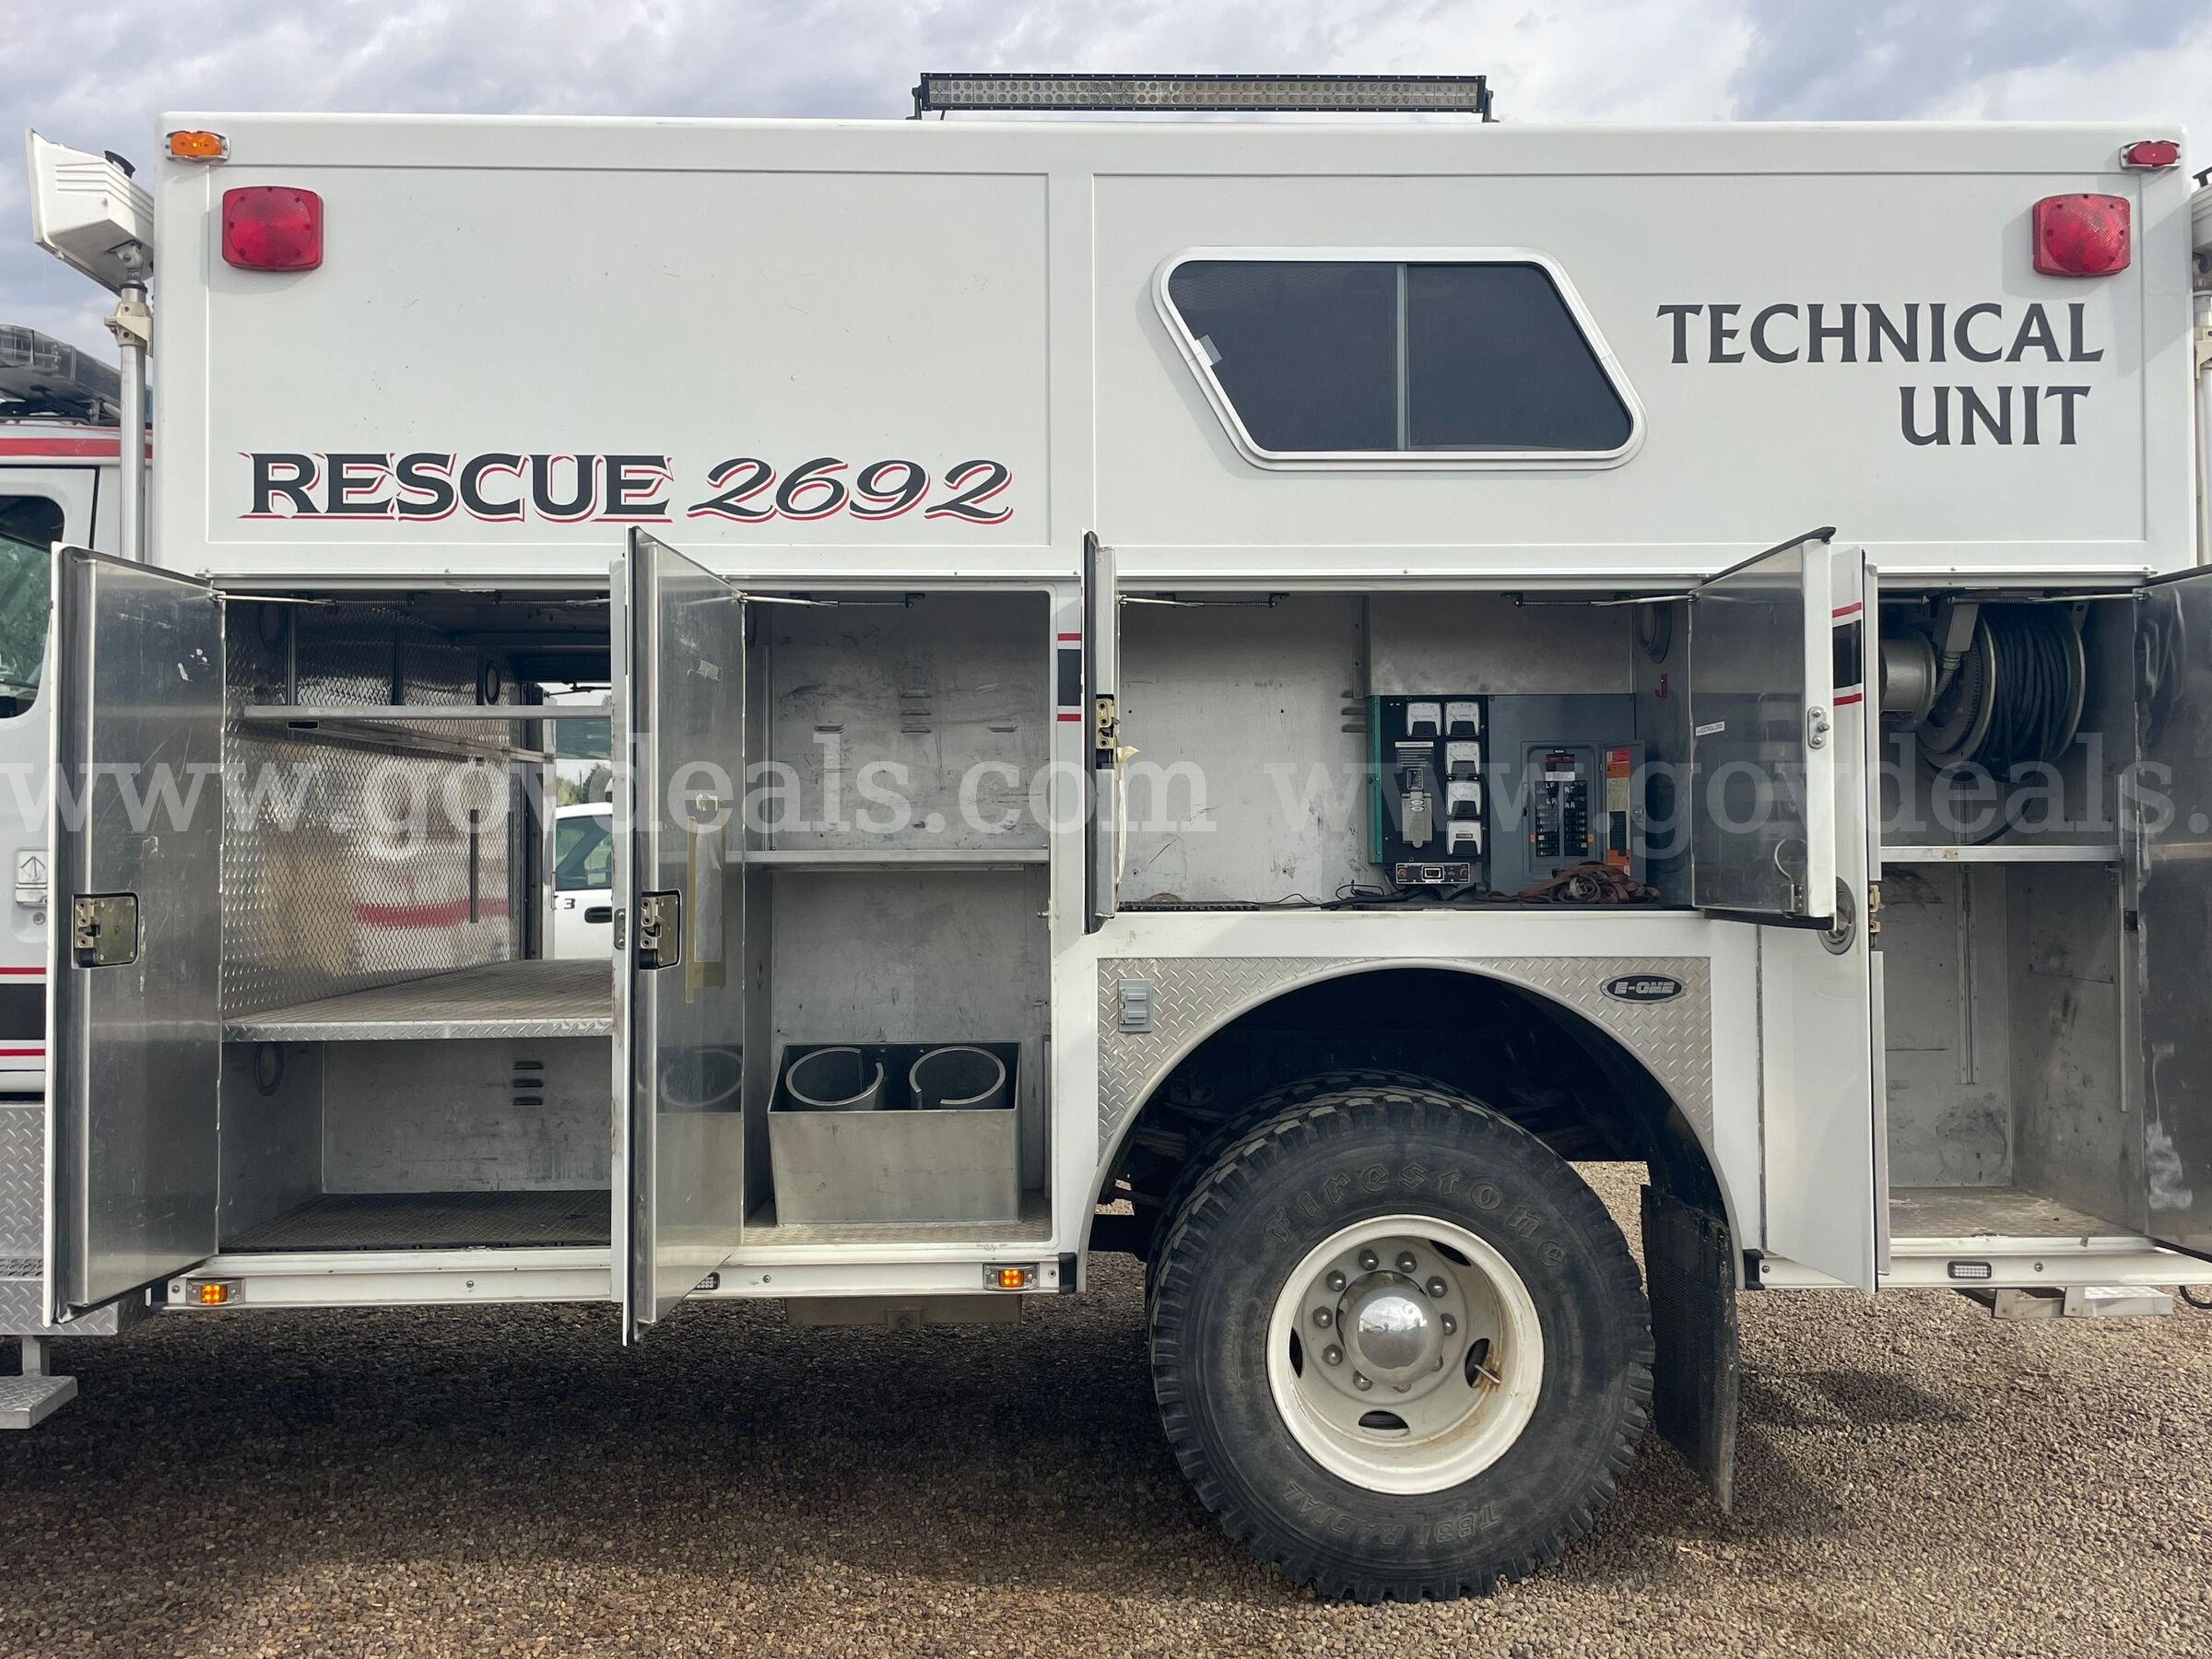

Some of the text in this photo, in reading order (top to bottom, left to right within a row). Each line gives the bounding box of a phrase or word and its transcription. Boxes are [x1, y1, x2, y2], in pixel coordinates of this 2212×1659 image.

[1655, 302, 2105, 364] TECHNICAL
[1899, 385, 2092, 446] UNIT
[239, 452, 1014, 524] RESCUE 2692
[563, 898, 576, 910] 3
[1614, 982, 1675, 994] E-ONE
[1265, 1162, 1566, 1267] Firestone
[1280, 1481, 1405, 1546] RADIAL
